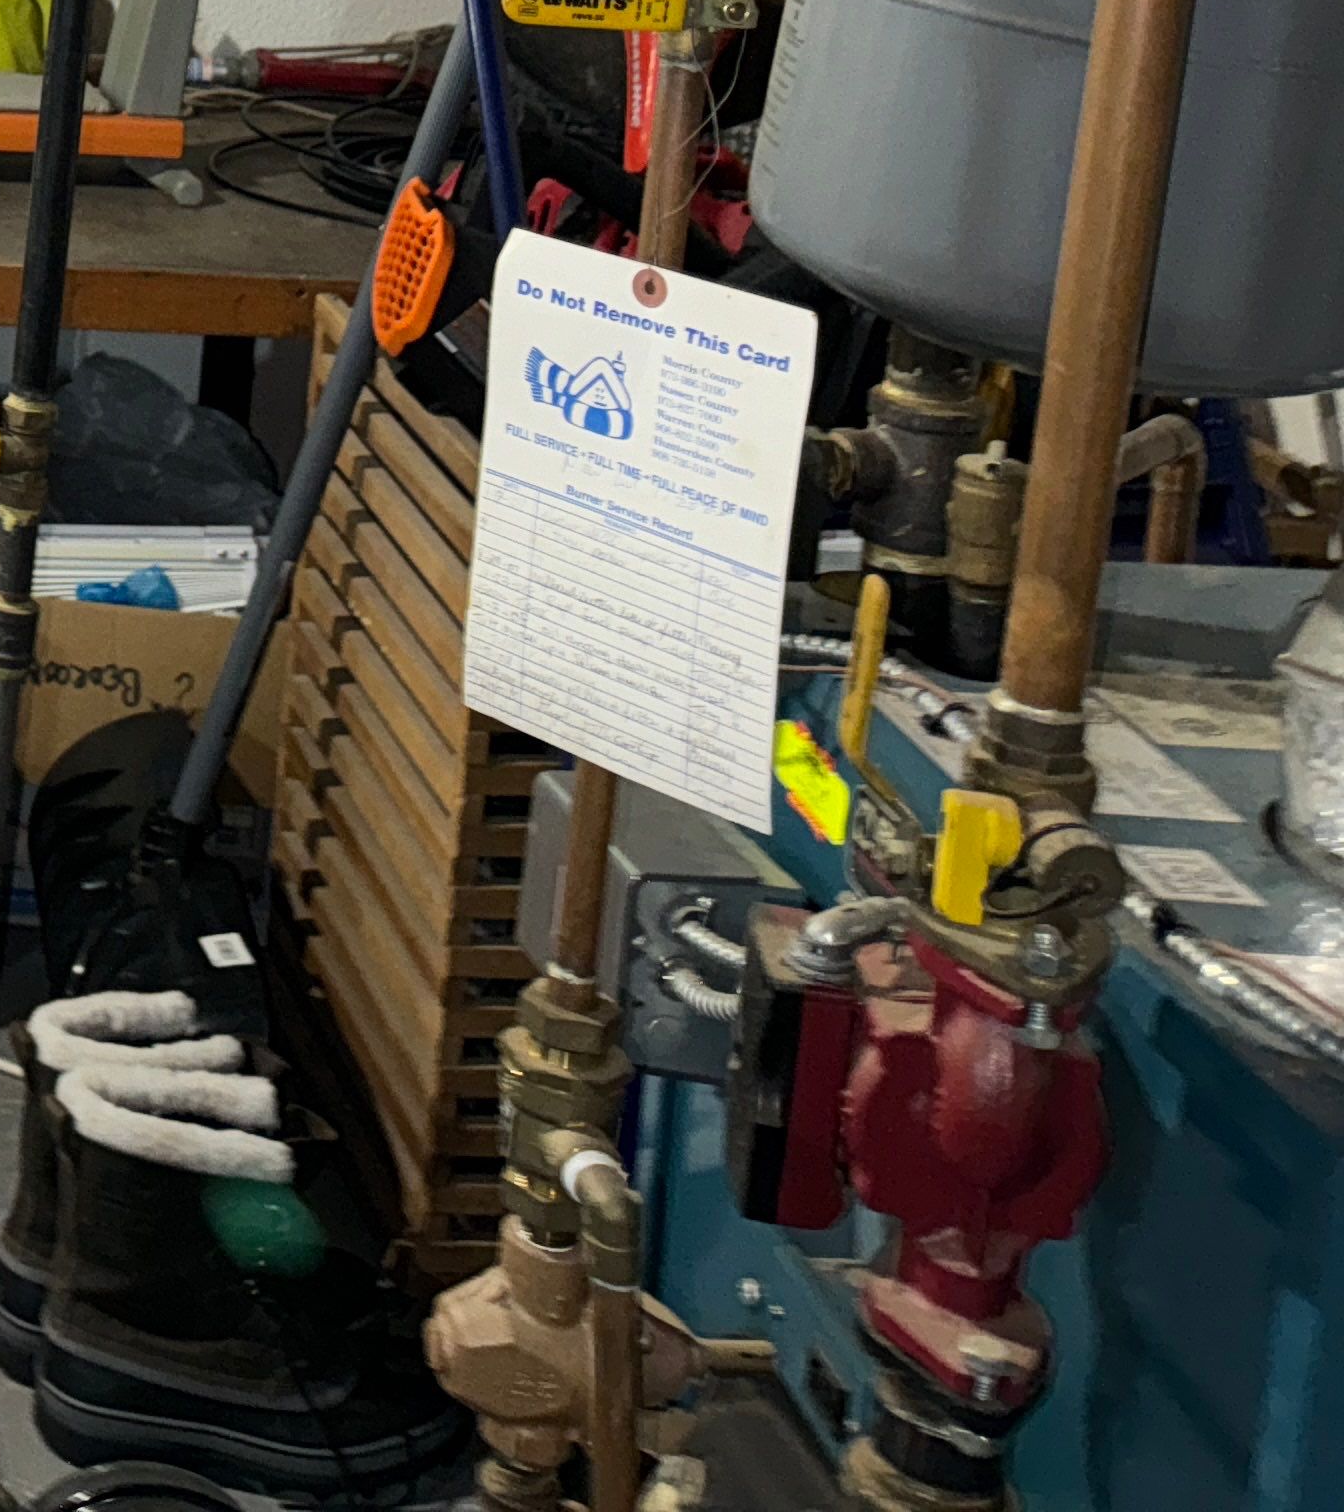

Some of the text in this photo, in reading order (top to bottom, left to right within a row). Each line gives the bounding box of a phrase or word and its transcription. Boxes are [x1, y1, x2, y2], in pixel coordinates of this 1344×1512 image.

[517, 279, 791, 372] Do Not Remove This Card
[662, 355, 744, 389] Morris County
[697, 394, 739, 417] County
[698, 420, 740, 446] County
[505, 423, 769, 526] FULL SERVICE FULL TIME FULL PEACE OF MIND
[716, 455, 756, 479] County
[606, 498, 649, 524] Service
[652, 516, 694, 540] Record
